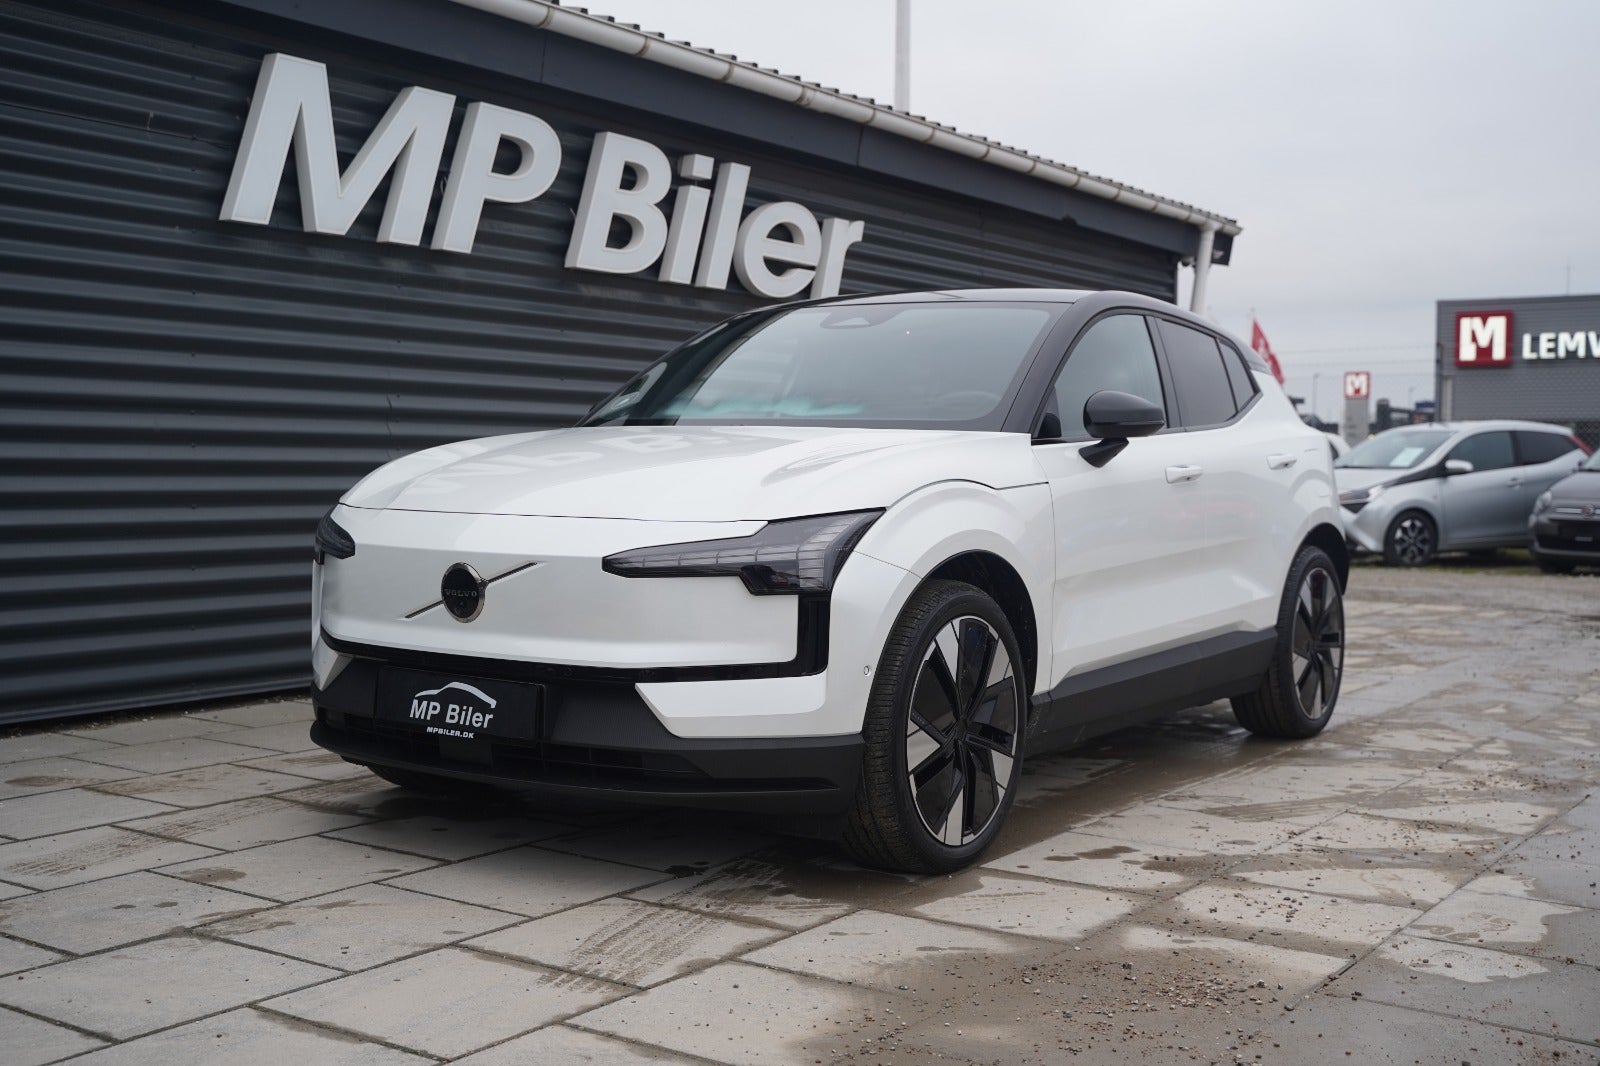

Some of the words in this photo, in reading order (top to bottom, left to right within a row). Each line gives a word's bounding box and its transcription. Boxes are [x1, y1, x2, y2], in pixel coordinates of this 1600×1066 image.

[219, 52, 562, 254] MP
[564, 131, 864, 299] Biler
[444, 589, 477, 597] VOLVO
[409, 699, 441, 720] MP
[445, 703, 494, 728] Biler
[426, 726, 474, 739] MPBILER.DK
